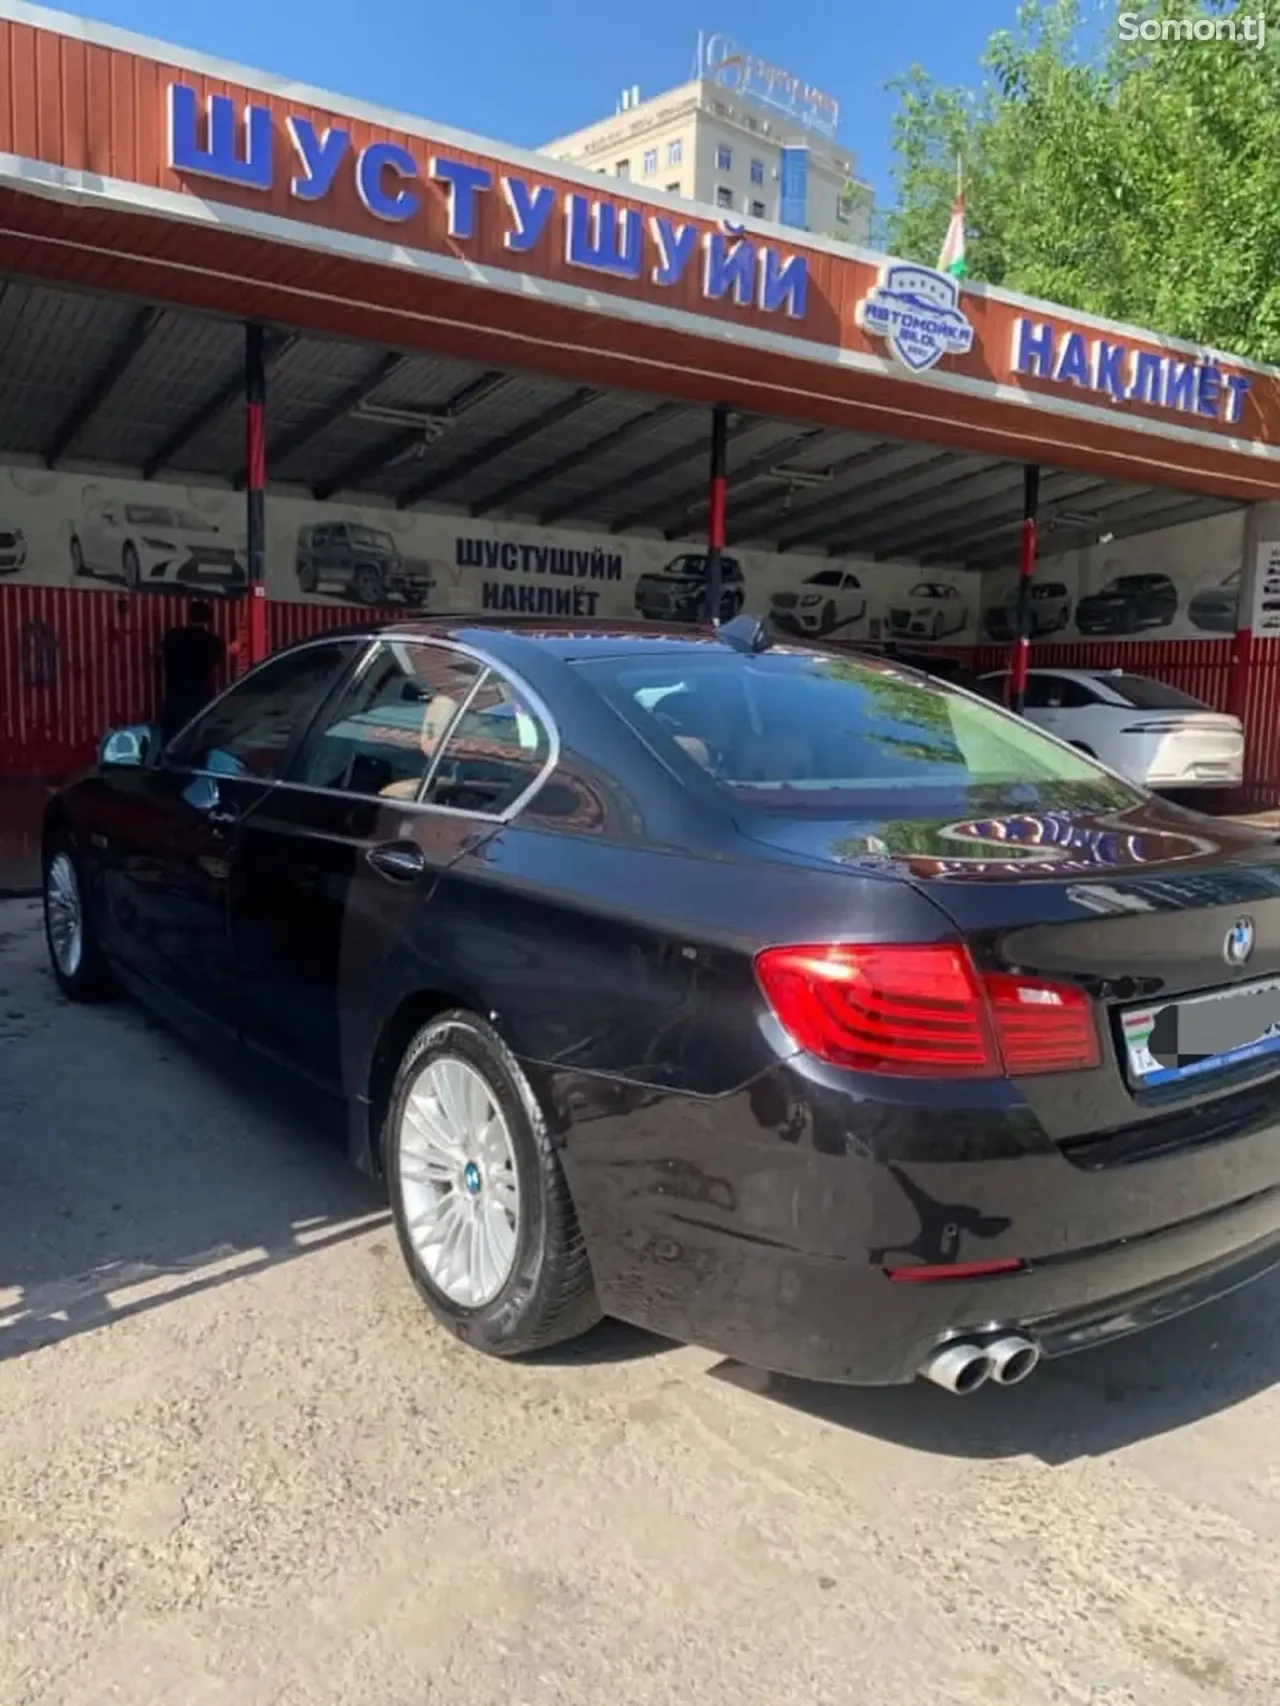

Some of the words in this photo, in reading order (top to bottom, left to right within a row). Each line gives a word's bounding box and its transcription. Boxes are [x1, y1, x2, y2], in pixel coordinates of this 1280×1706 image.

[167, 81, 808, 320] ШУСТУШУЙИ
[1010, 317, 1252, 424] НАҚЛИЁТ
[865, 303, 972, 342] АВТОМОЙКА
[455, 537, 623, 581] ШУСТУШУЙИ
